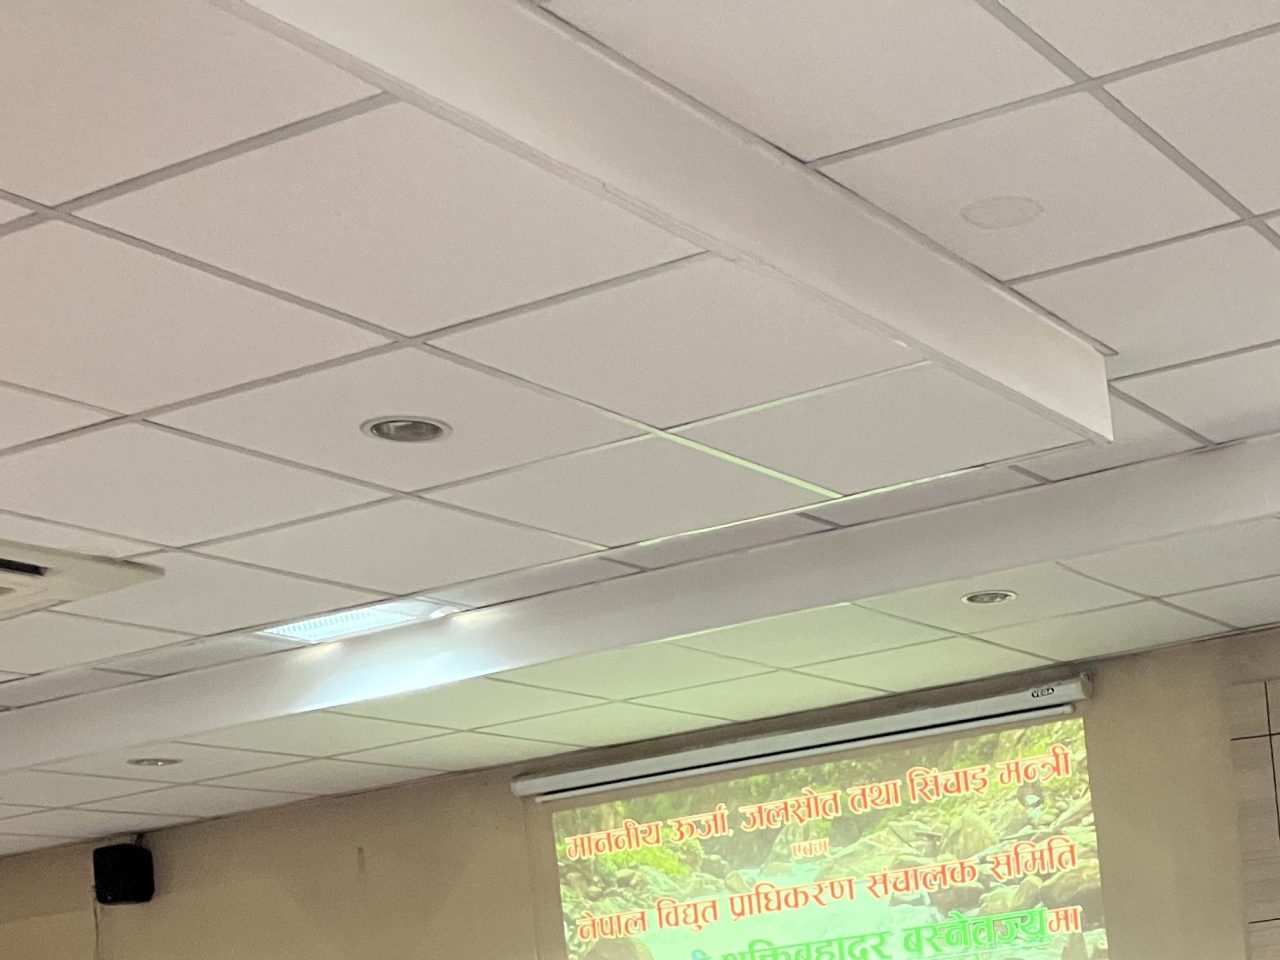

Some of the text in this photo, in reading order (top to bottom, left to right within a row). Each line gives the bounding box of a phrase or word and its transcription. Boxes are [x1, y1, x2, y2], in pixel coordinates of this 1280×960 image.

[566, 820, 662, 860] माननीय
[847, 779, 901, 814] तथा
[997, 743, 1072, 787] मन्त्री
[577, 836, 1079, 942] नेपाल विद्युत प्राधिकरण संचालक समिति
